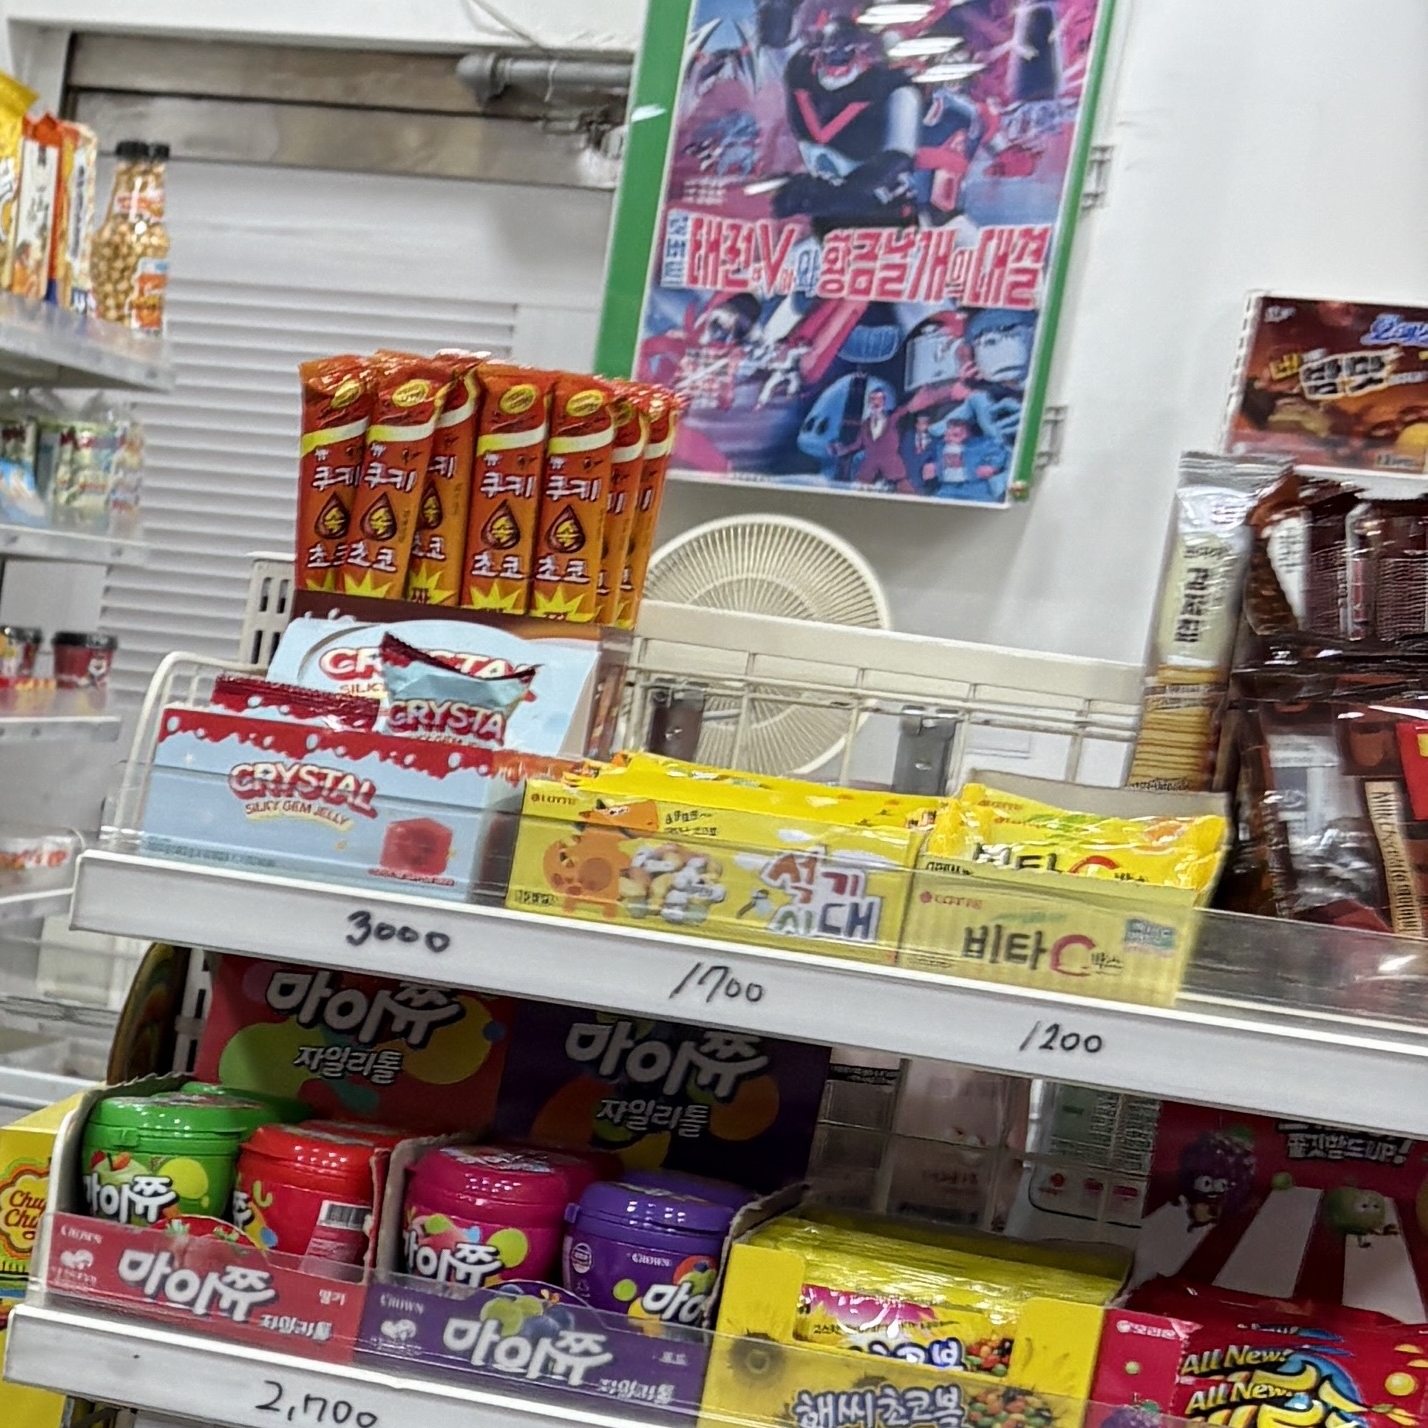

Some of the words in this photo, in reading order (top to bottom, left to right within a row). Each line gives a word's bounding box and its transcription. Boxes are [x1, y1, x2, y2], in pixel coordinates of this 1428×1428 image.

[965, 226, 1050, 310] 대결
[363, 457, 418, 494] 쿠키
[480, 471, 536, 500] 쿠키
[545, 472, 601, 502] 쿠키
[348, 538, 397, 572] 초코
[471, 552, 526, 580] 초코
[536, 556, 591, 583] 초코
[388, 702, 506, 748] CRYSTA
[229, 760, 378, 818] CRYSTAL
[345, 910, 452, 954] 3000
[961, 922, 1098, 977] 비타C
[265, 970, 465, 1046] 마이쮸
[563, 1018, 773, 1101] 마이쮸
[1018, 1021, 1104, 1056] 1200
[292, 1044, 405, 1087] 자일리톨
[595, 1097, 712, 1140] 자일리톨
[631, 1253, 672, 1269] CROWN
[116, 1247, 278, 1323] 마이쮸
[379, 1293, 426, 1315] CROWN
[643, 1280, 707, 1330] 마이
[443, 1315, 613, 1388] 마이쮸
[1180, 1348, 1224, 1376] All
[1184, 1383, 1229, 1416] All
